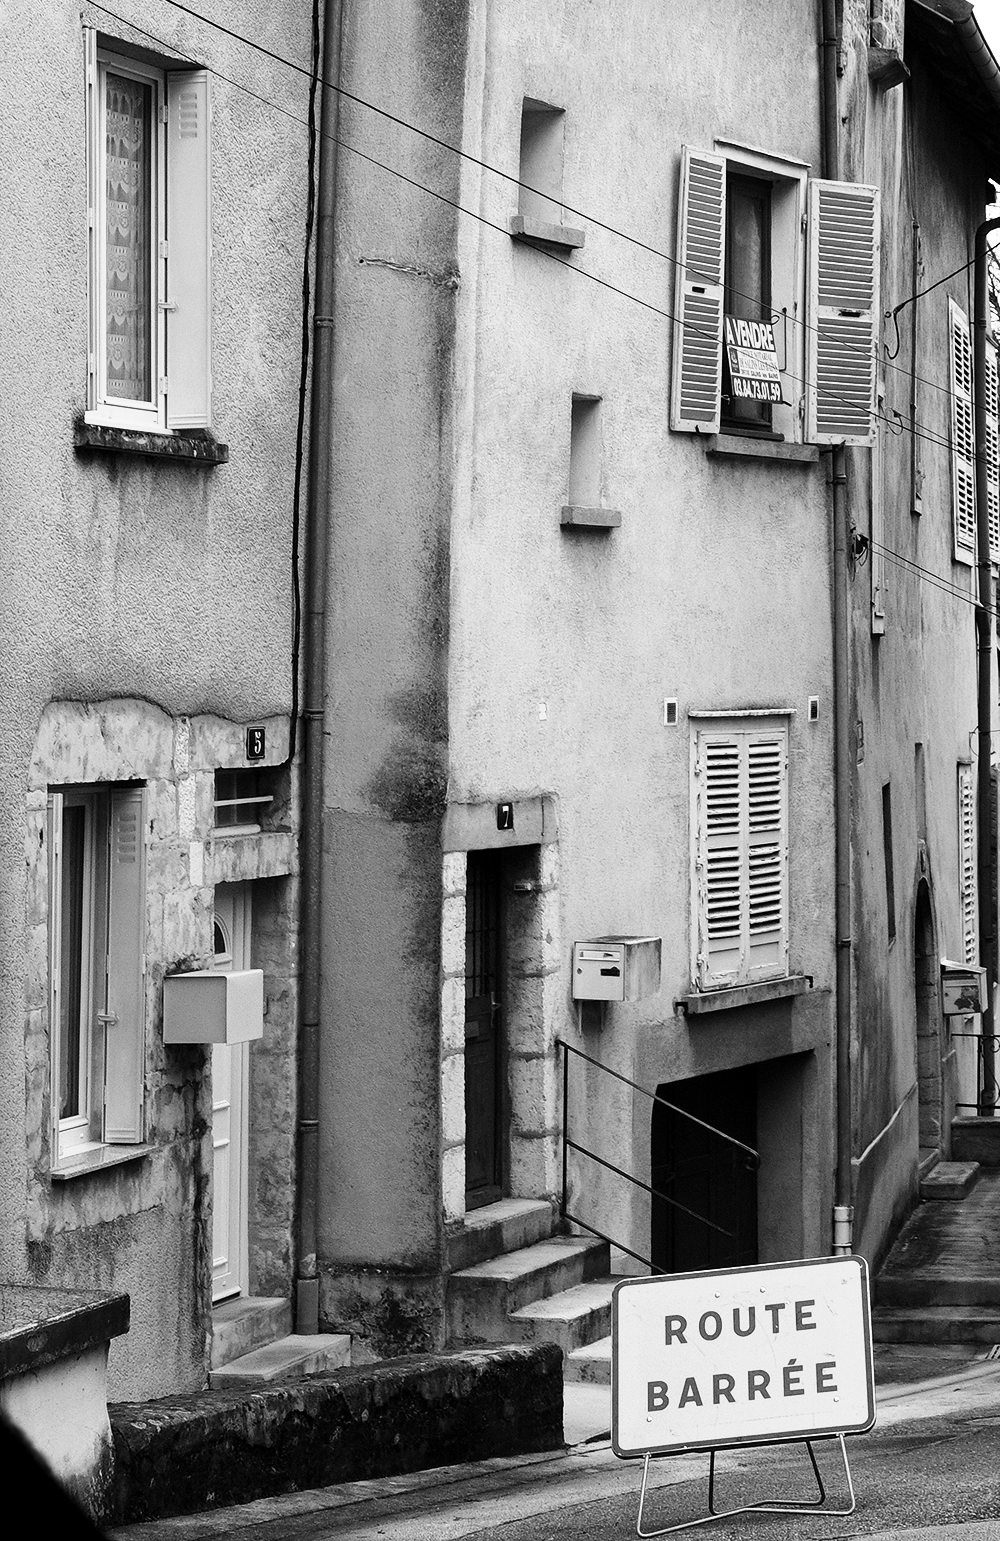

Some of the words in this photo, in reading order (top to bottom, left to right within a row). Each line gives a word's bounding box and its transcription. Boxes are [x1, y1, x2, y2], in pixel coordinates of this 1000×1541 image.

[726, 317, 735, 345] A
[732, 318, 775, 351] VENDRE
[734, 377, 780, 401] 03.84.73.01.59
[254, 731, 261, 754] 5
[502, 805, 509, 827] 7
[664, 1299, 817, 1345] ROUTE
[647, 1358, 838, 1412] BARRÉE
